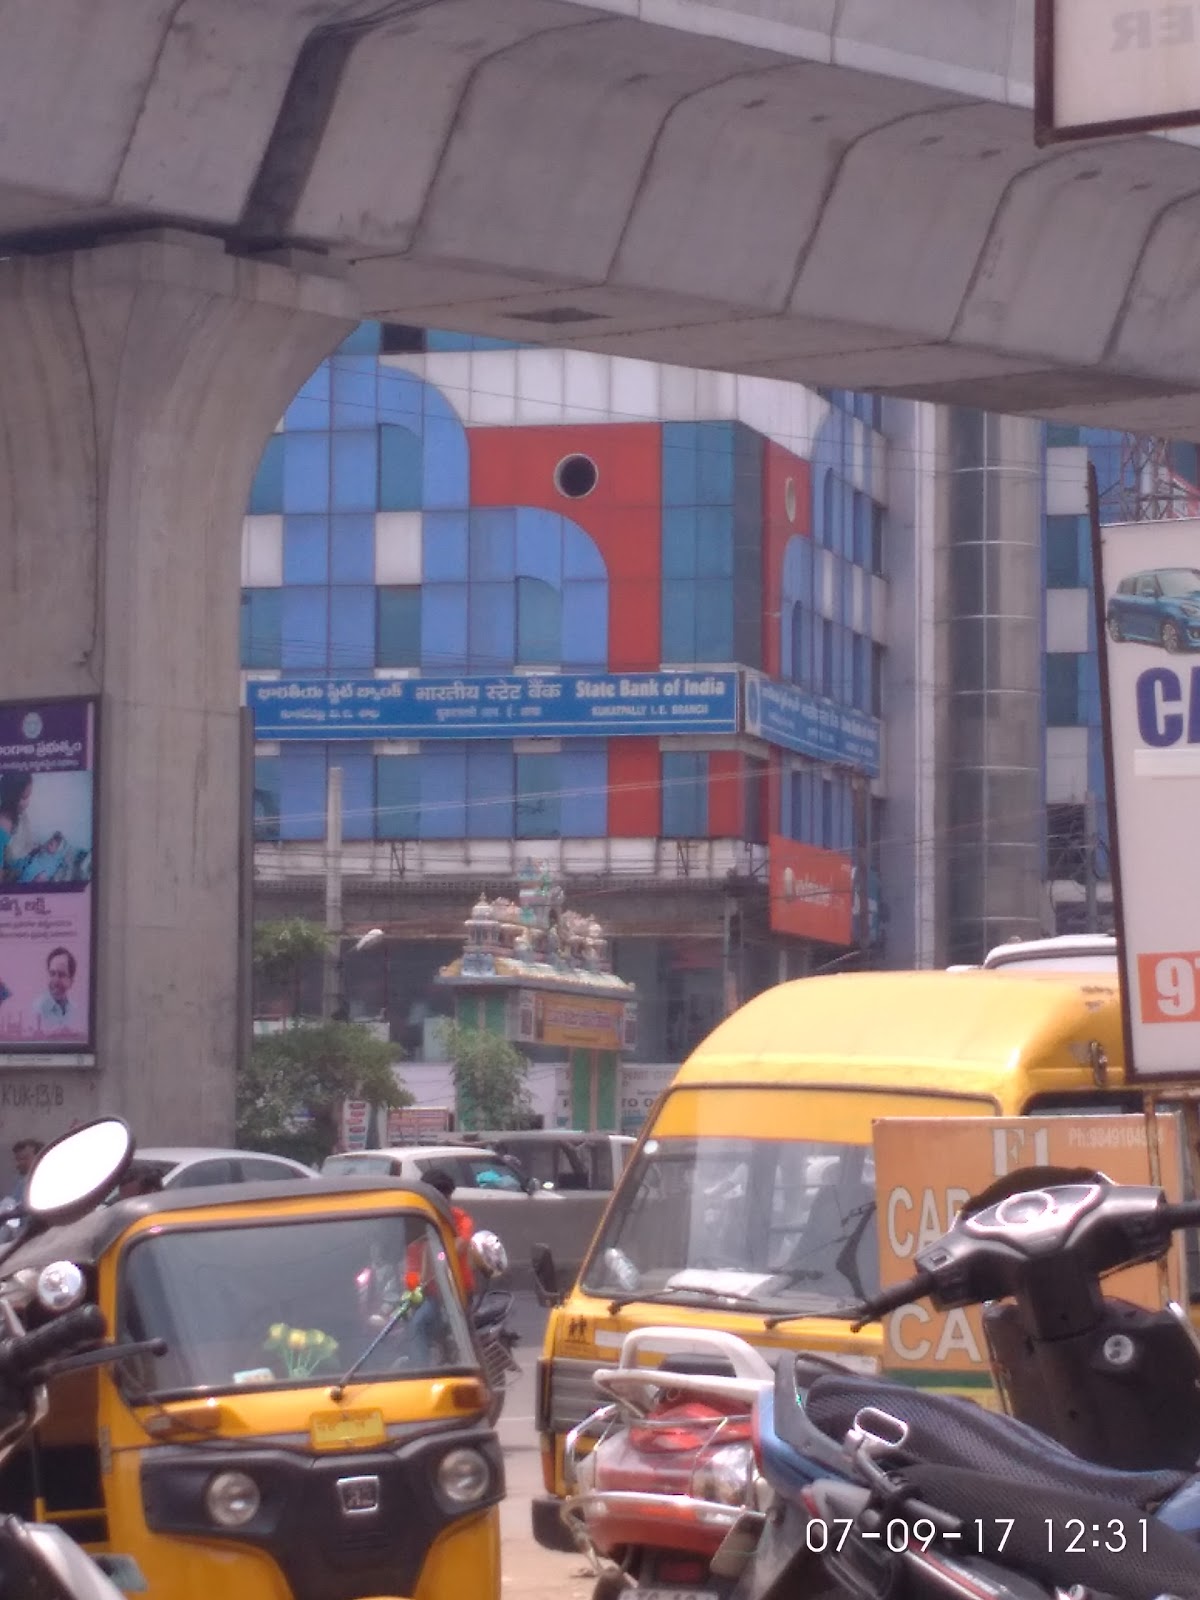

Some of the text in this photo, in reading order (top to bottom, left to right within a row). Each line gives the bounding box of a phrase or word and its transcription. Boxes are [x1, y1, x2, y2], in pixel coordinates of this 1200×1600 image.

[415, 680, 480, 700] भारतीय
[485, 679, 522, 699] स्टेट
[575, 677, 725, 698] State Bank of India
[1155, 957, 1200, 1017] 9
